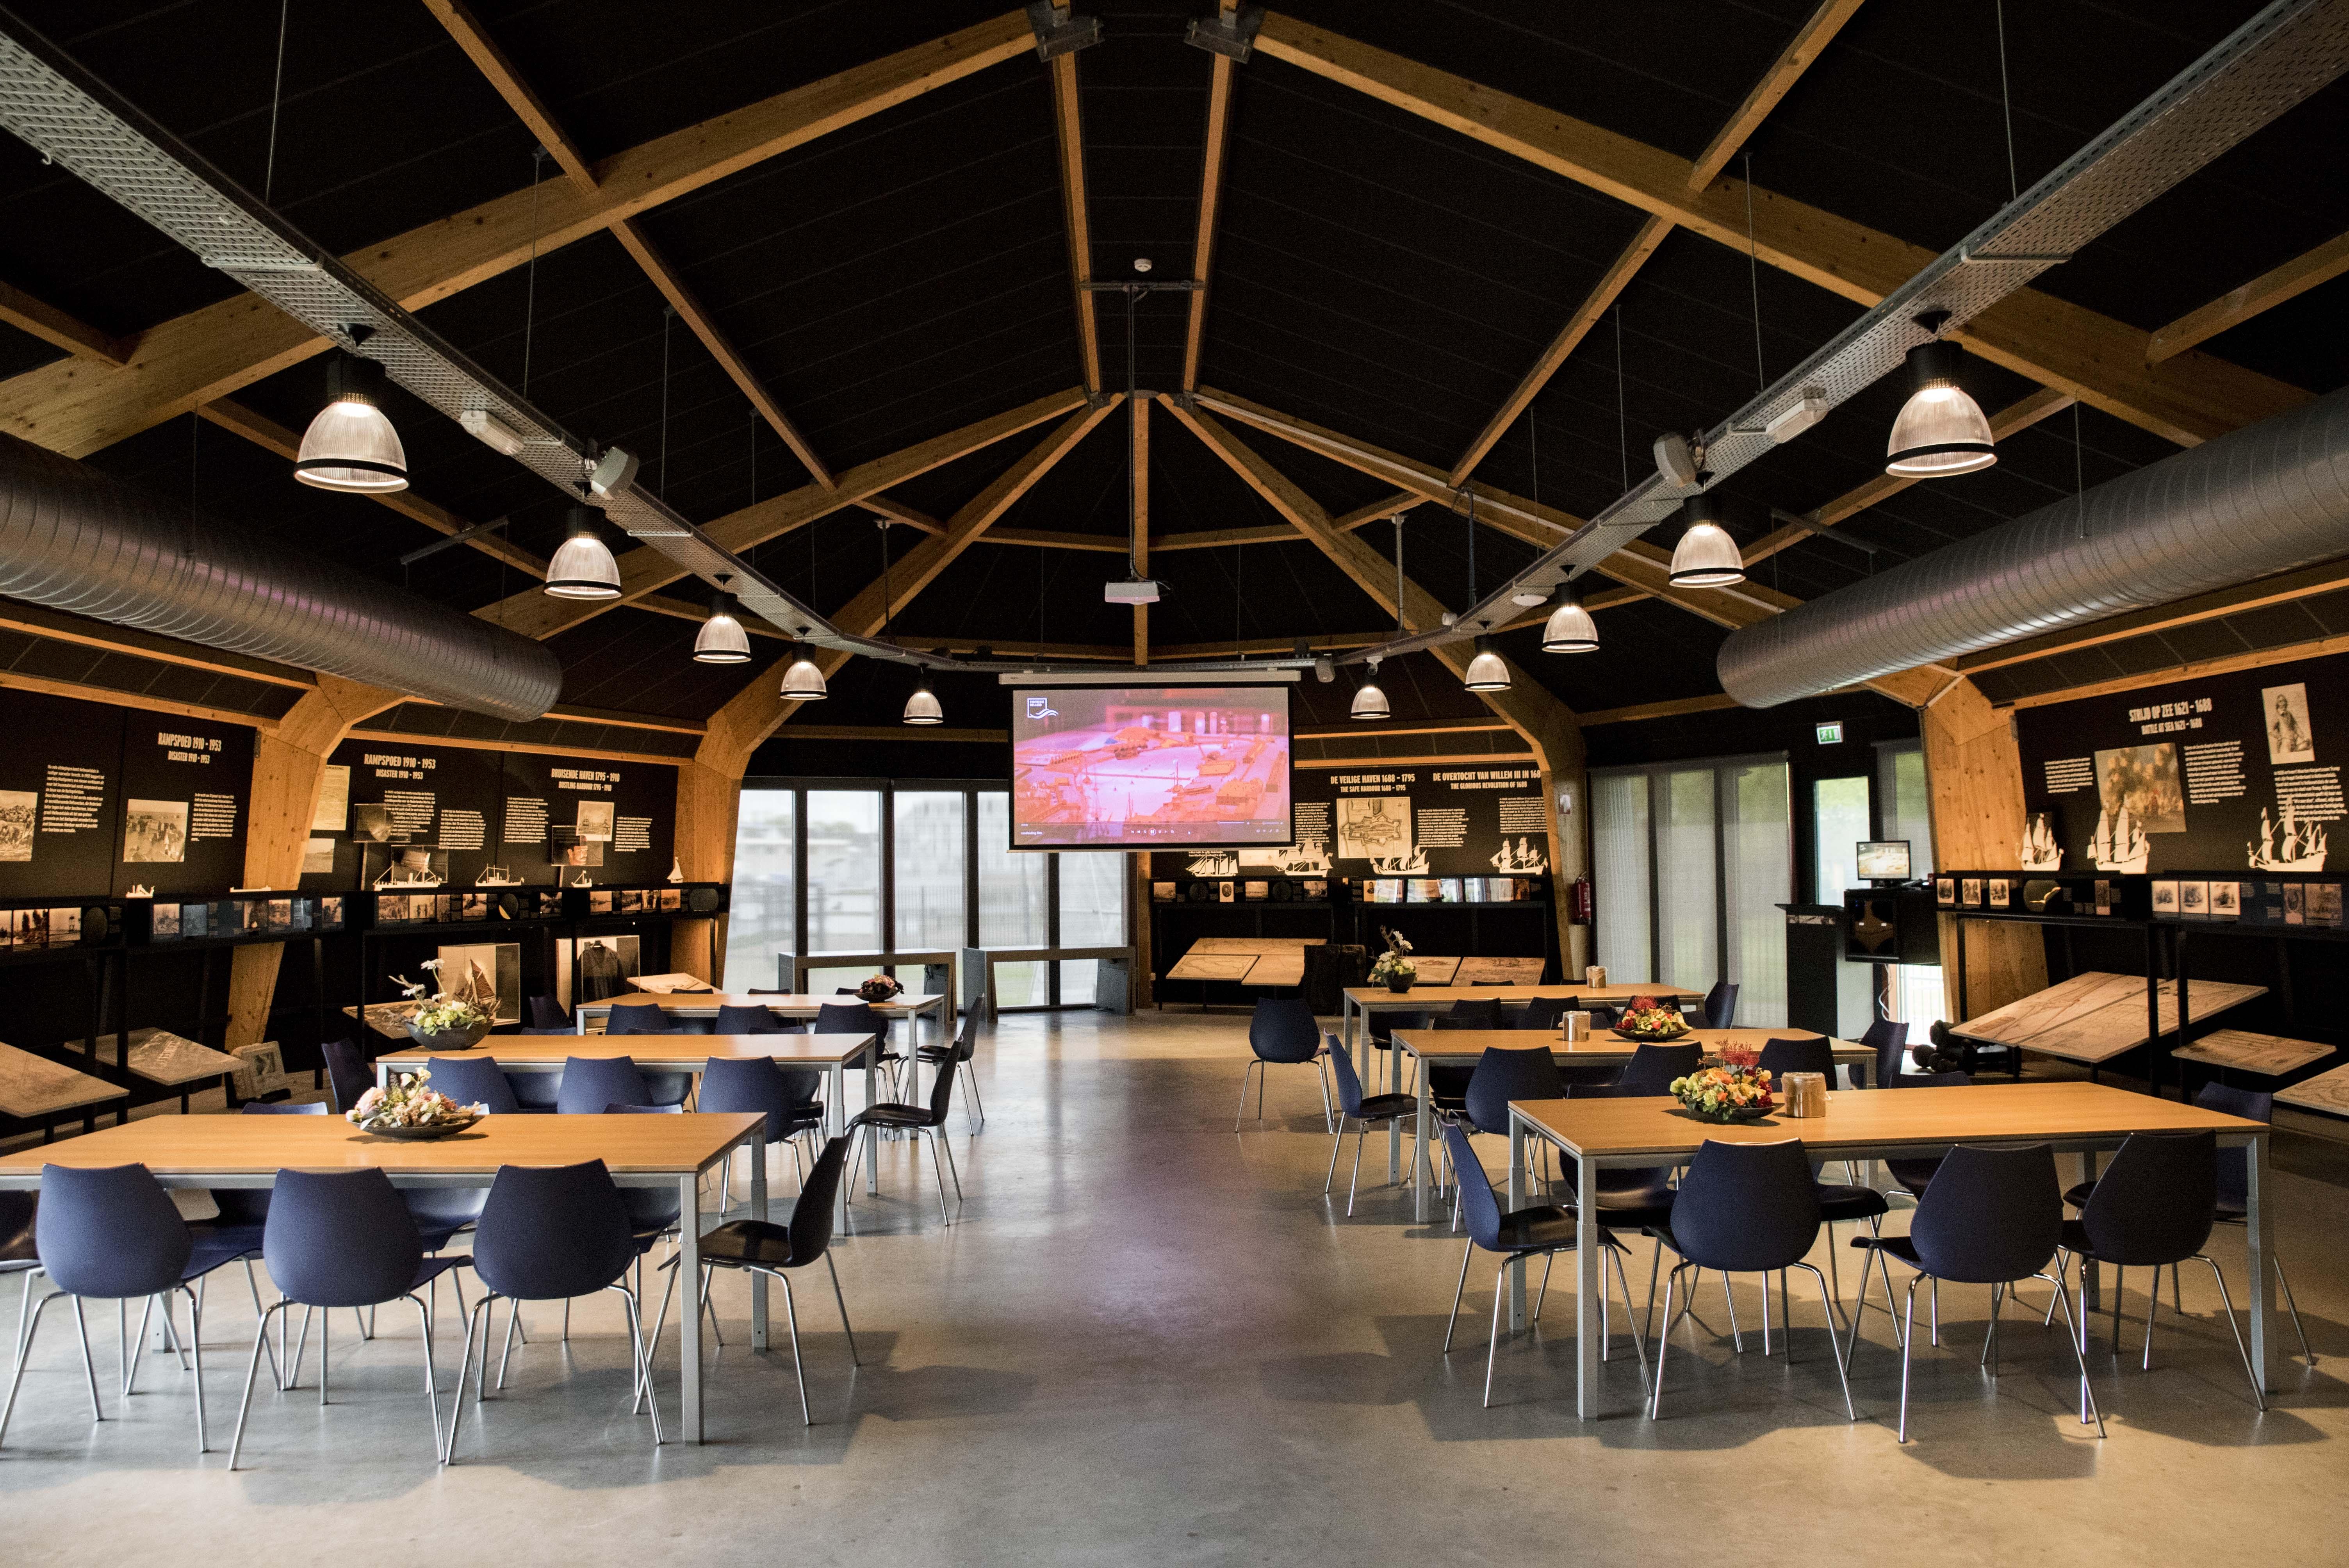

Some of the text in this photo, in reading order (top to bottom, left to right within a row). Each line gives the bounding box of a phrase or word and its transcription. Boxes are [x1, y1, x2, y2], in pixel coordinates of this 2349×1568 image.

[2129, 707, 2151, 722] STRIJD
[2151, 706, 2160, 719] OP
[2161, 704, 2174, 717] ZEE
[2174, 701, 2189, 715] 1621
[2195, 698, 2212, 713] 1688
[2164, 722, 2175, 732] SEA
[2174, 720, 2186, 731] 1621
[2190, 718, 2203, 728] 1688
[158, 732, 191, 748] RAMPSPOED
[192, 737, 204, 749] 1910
[209, 739, 221, 752] 1953
[168, 751, 188, 761] DISASTER
[188, 753, 197, 762] 1910
[200, 755, 210, 764] 1953
[364, 754, 401, 766] RAMPSPOED
[403, 757, 416, 768] 1910
[422, 759, 435, 769] 1953
[376, 769, 398, 778] DISASTER
[551, 768, 578, 779] BRUISENDE
[579, 771, 594, 780] HAVEN
[595, 772, 606, 781] 1795
[610, 773, 620, 782] 1910
[1339, 775, 1360, 784] VEILIGE
[1382, 774, 1395, 782] 1688
[1442, 772, 1476, 781] OVERTOCHT
[1477, 772, 1489, 780] VAN
[1490, 771, 1512, 779] WILLEM
[1531, 769, 1541, 778] 168
